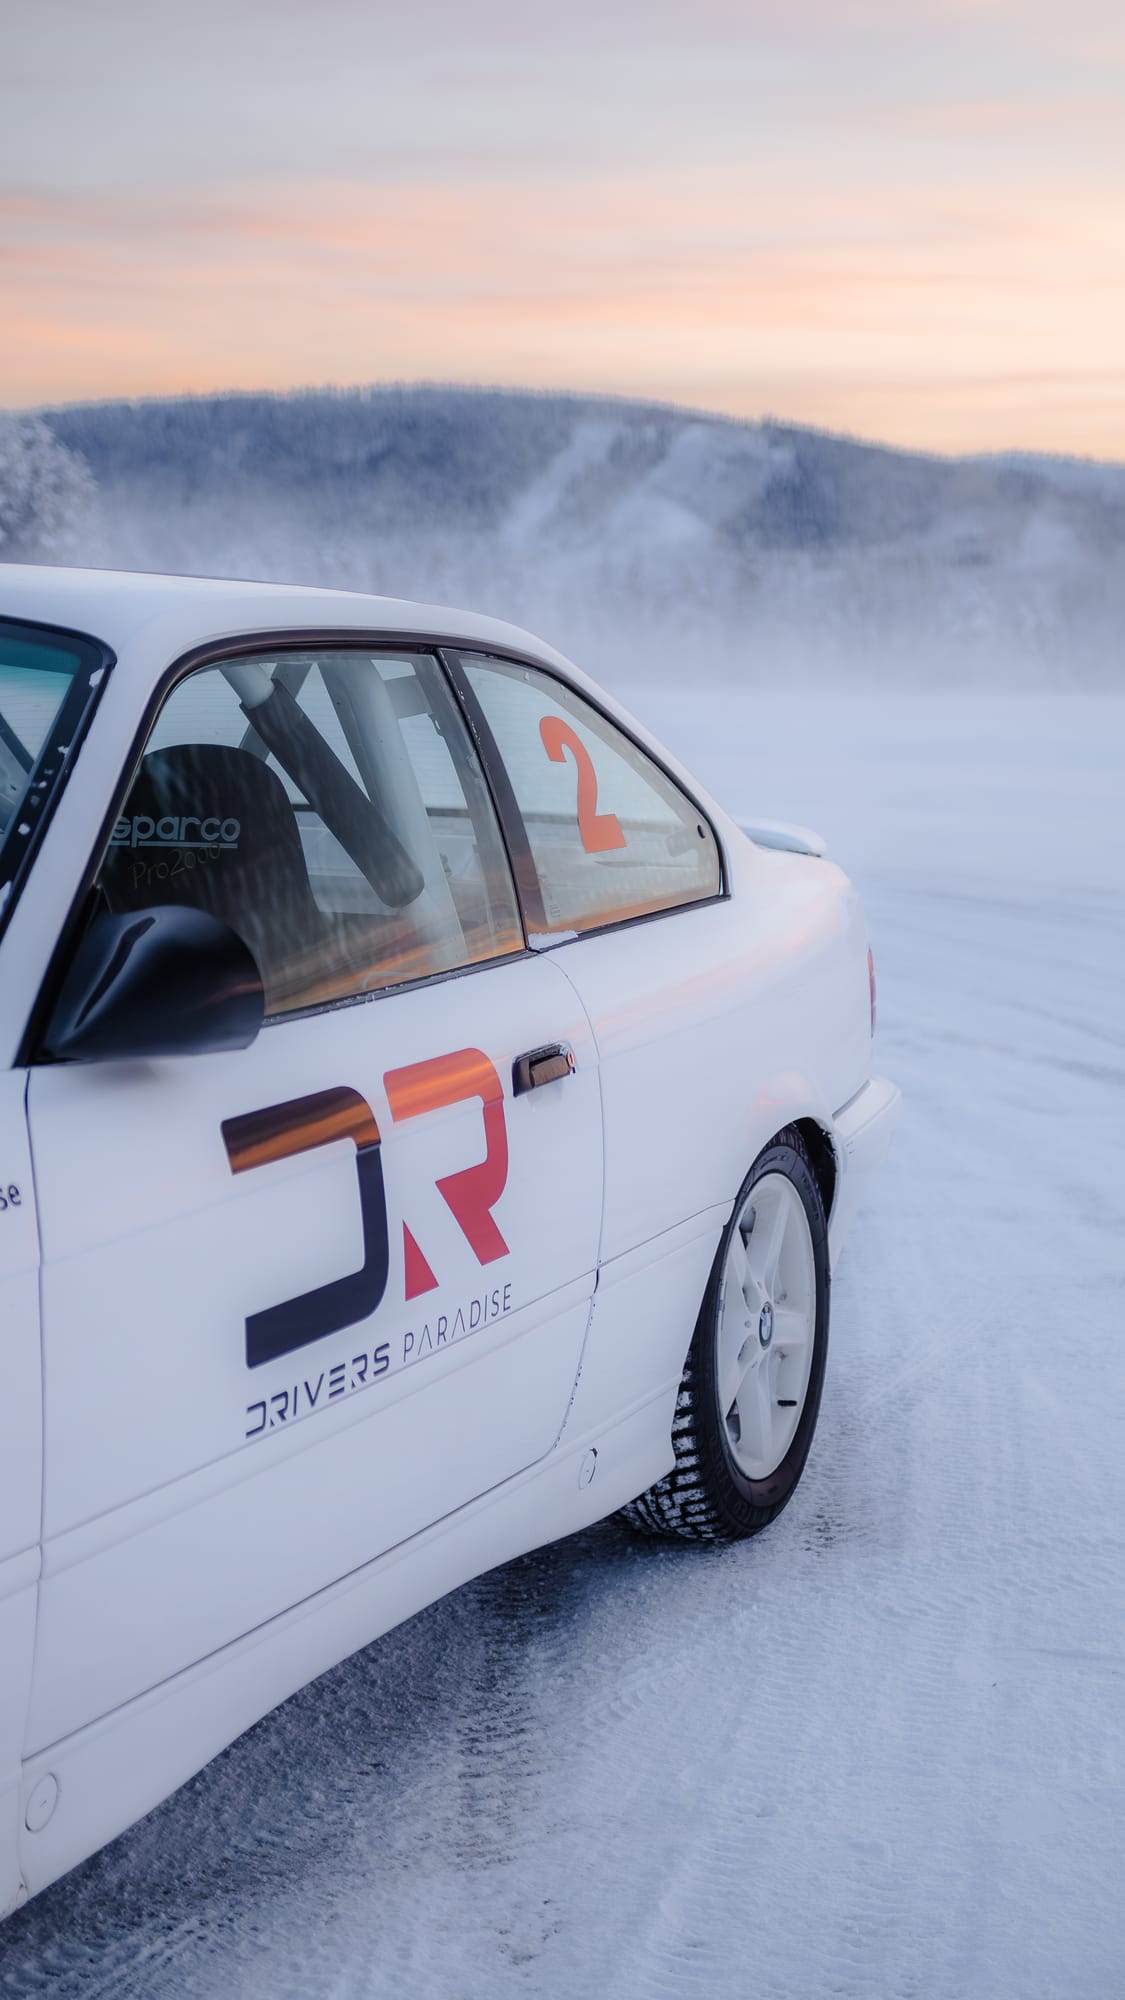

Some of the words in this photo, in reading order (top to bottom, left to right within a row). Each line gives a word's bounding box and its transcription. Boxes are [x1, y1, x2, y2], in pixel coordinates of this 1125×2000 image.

[111, 815, 241, 848] sparco
[539, 715, 628, 854] 2
[128, 842, 222, 889] Pro2000
[220, 1047, 511, 1370] DR
[245, 1342, 391, 1439] DRIVERS
[402, 1282, 512, 1363] PARADISE
